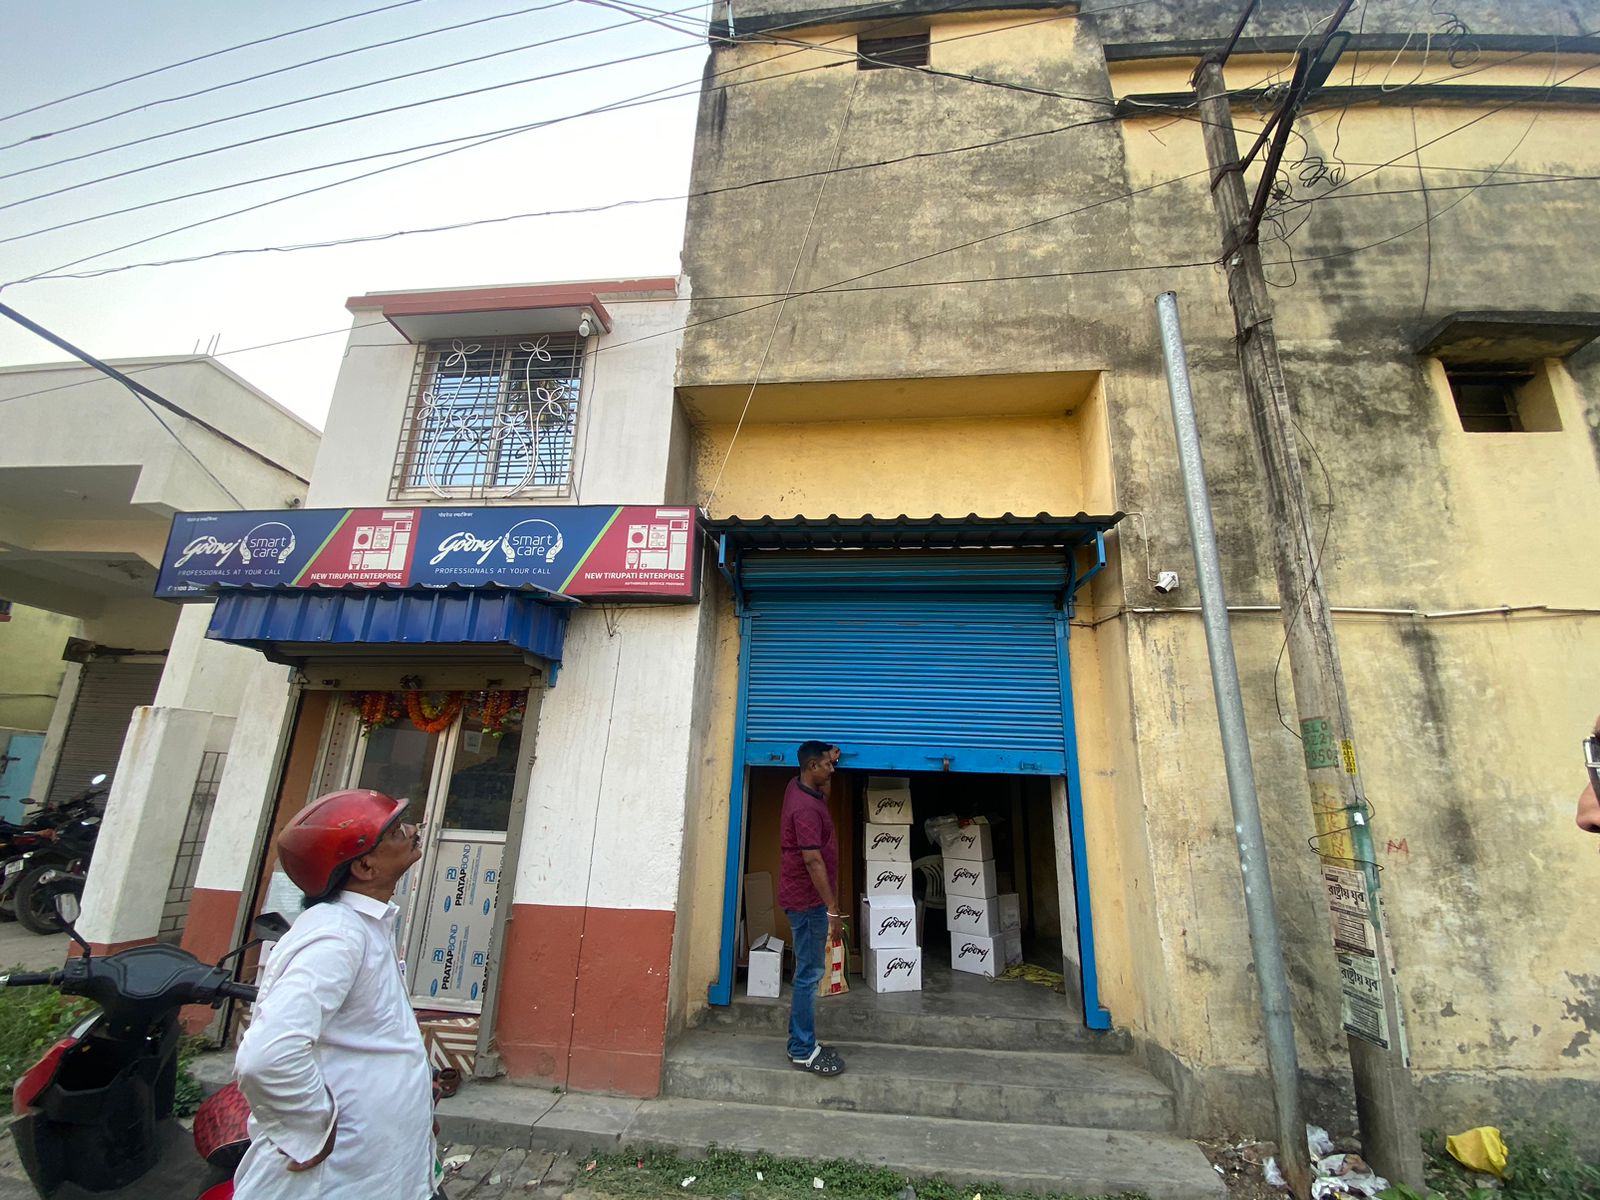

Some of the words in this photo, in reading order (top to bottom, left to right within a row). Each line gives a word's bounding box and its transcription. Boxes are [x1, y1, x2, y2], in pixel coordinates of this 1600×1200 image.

[249, 536, 287, 548] smart
[429, 531, 502, 565] Godrej
[513, 532, 552, 546] smart
[174, 536, 241, 567] Godrej
[252, 546, 279, 559] care
[516, 544, 546, 557] care
[435, 567, 494, 575] PROFESSIONALS
[510, 567, 530, 575] YOUR
[532, 567, 552, 575] CALL
[584, 572, 603, 580] NEW
[603, 572, 638, 580] TIRUPATI
[639, 572, 685, 580] ENTERPRISE
[875, 797, 905, 816] Godrej
[871, 832, 905, 850] Godrej
[454, 844, 471, 907] PRATAPBOND
[873, 870, 908, 890] Godrej
[951, 867, 981, 886] Godrej
[1328, 884, 1350, 900] রাষ্ট্রীয়
[1350, 890, 1364, 905] যুব
[953, 904, 984, 924] Godrej
[877, 916, 912, 936] Godrej
[441, 924, 458, 990] PRATAPBOND
[958, 942, 990, 963] Godrej
[883, 957, 918, 978] Godrej
[1340, 967, 1364, 985] রাষ্ট্রীয়
[1364, 976, 1378, 992] যুব
